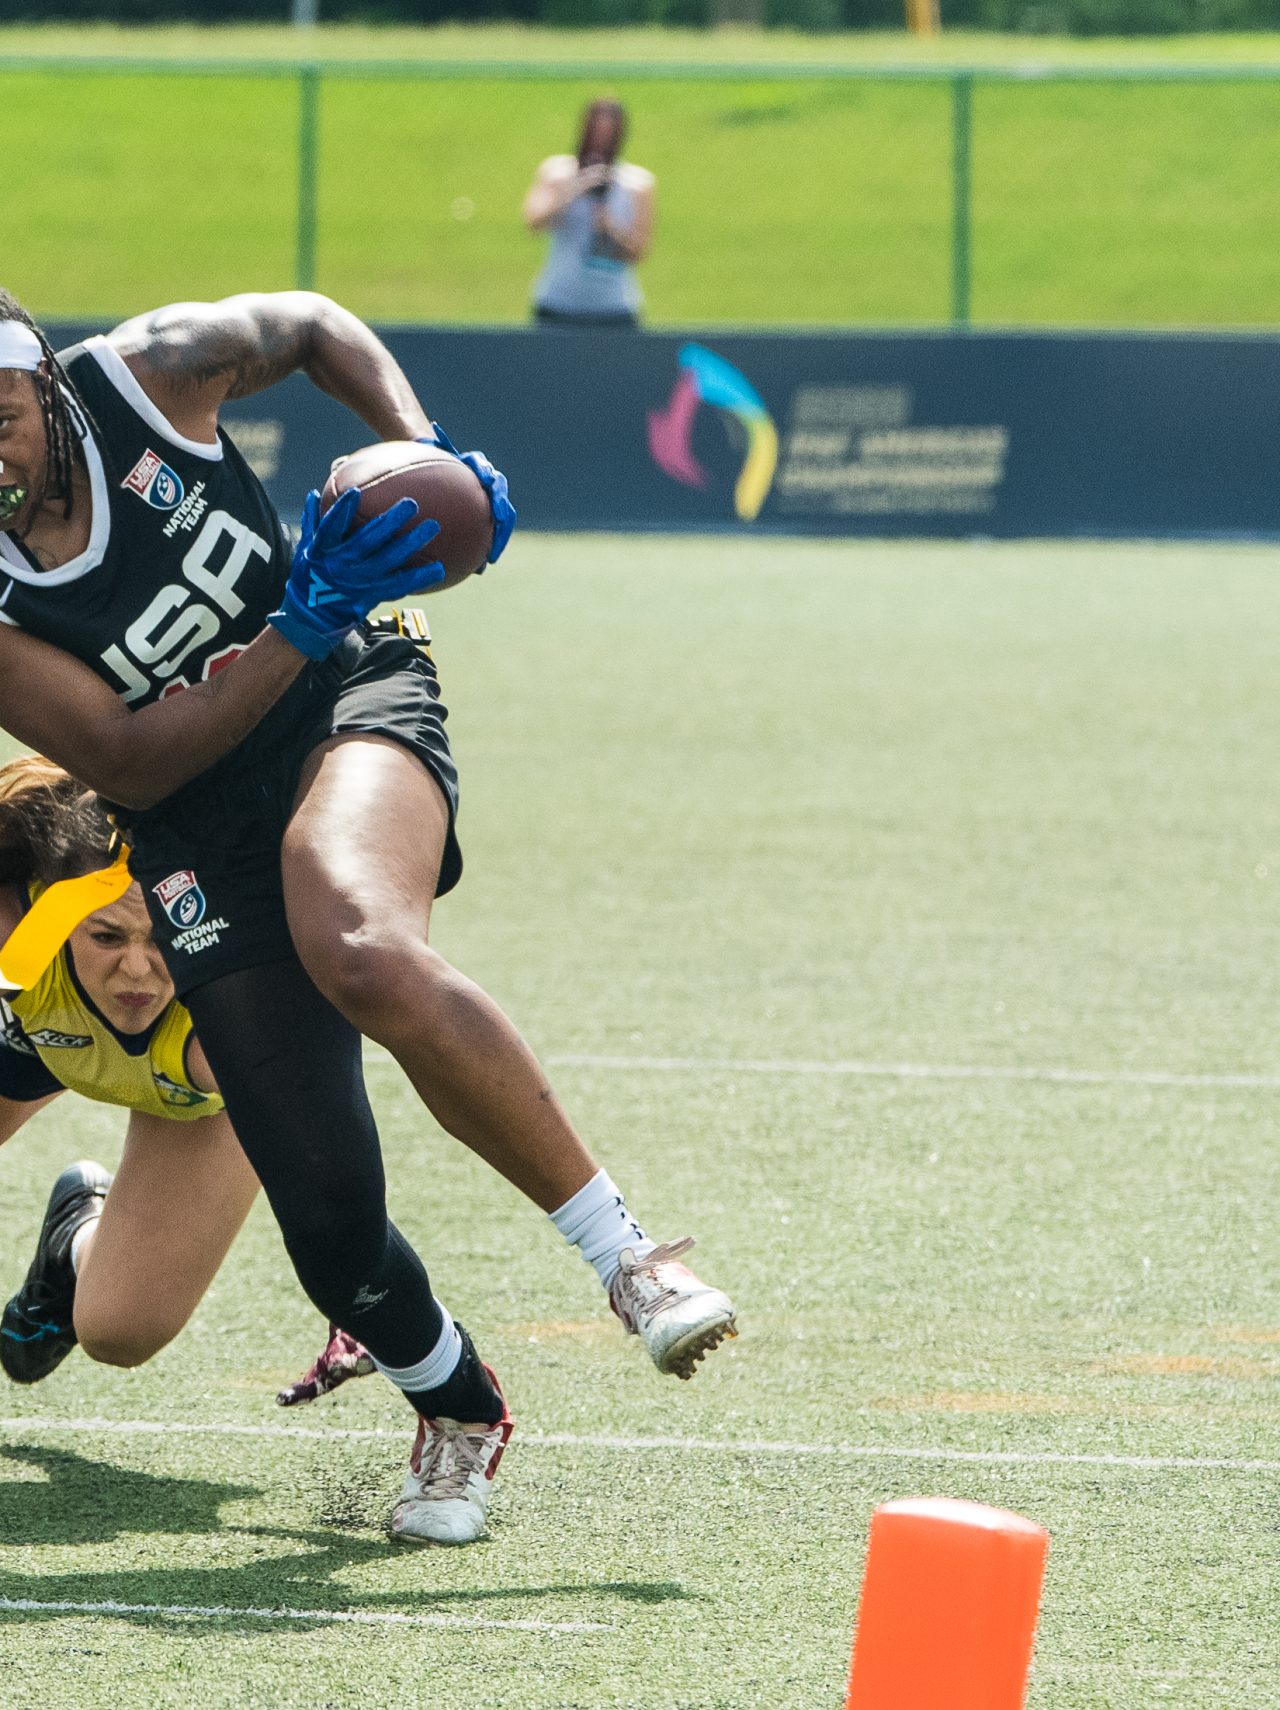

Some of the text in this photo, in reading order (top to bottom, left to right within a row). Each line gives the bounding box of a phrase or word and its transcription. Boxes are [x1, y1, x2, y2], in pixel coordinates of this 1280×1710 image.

[129, 456, 156, 486] USA
[162, 480, 206, 538] NATIONAL
[180, 497, 208, 532] TEAM
[160, 873, 190, 894] USA
[171, 917, 229, 951] NATIONAL
[184, 932, 220, 955] TEAM
